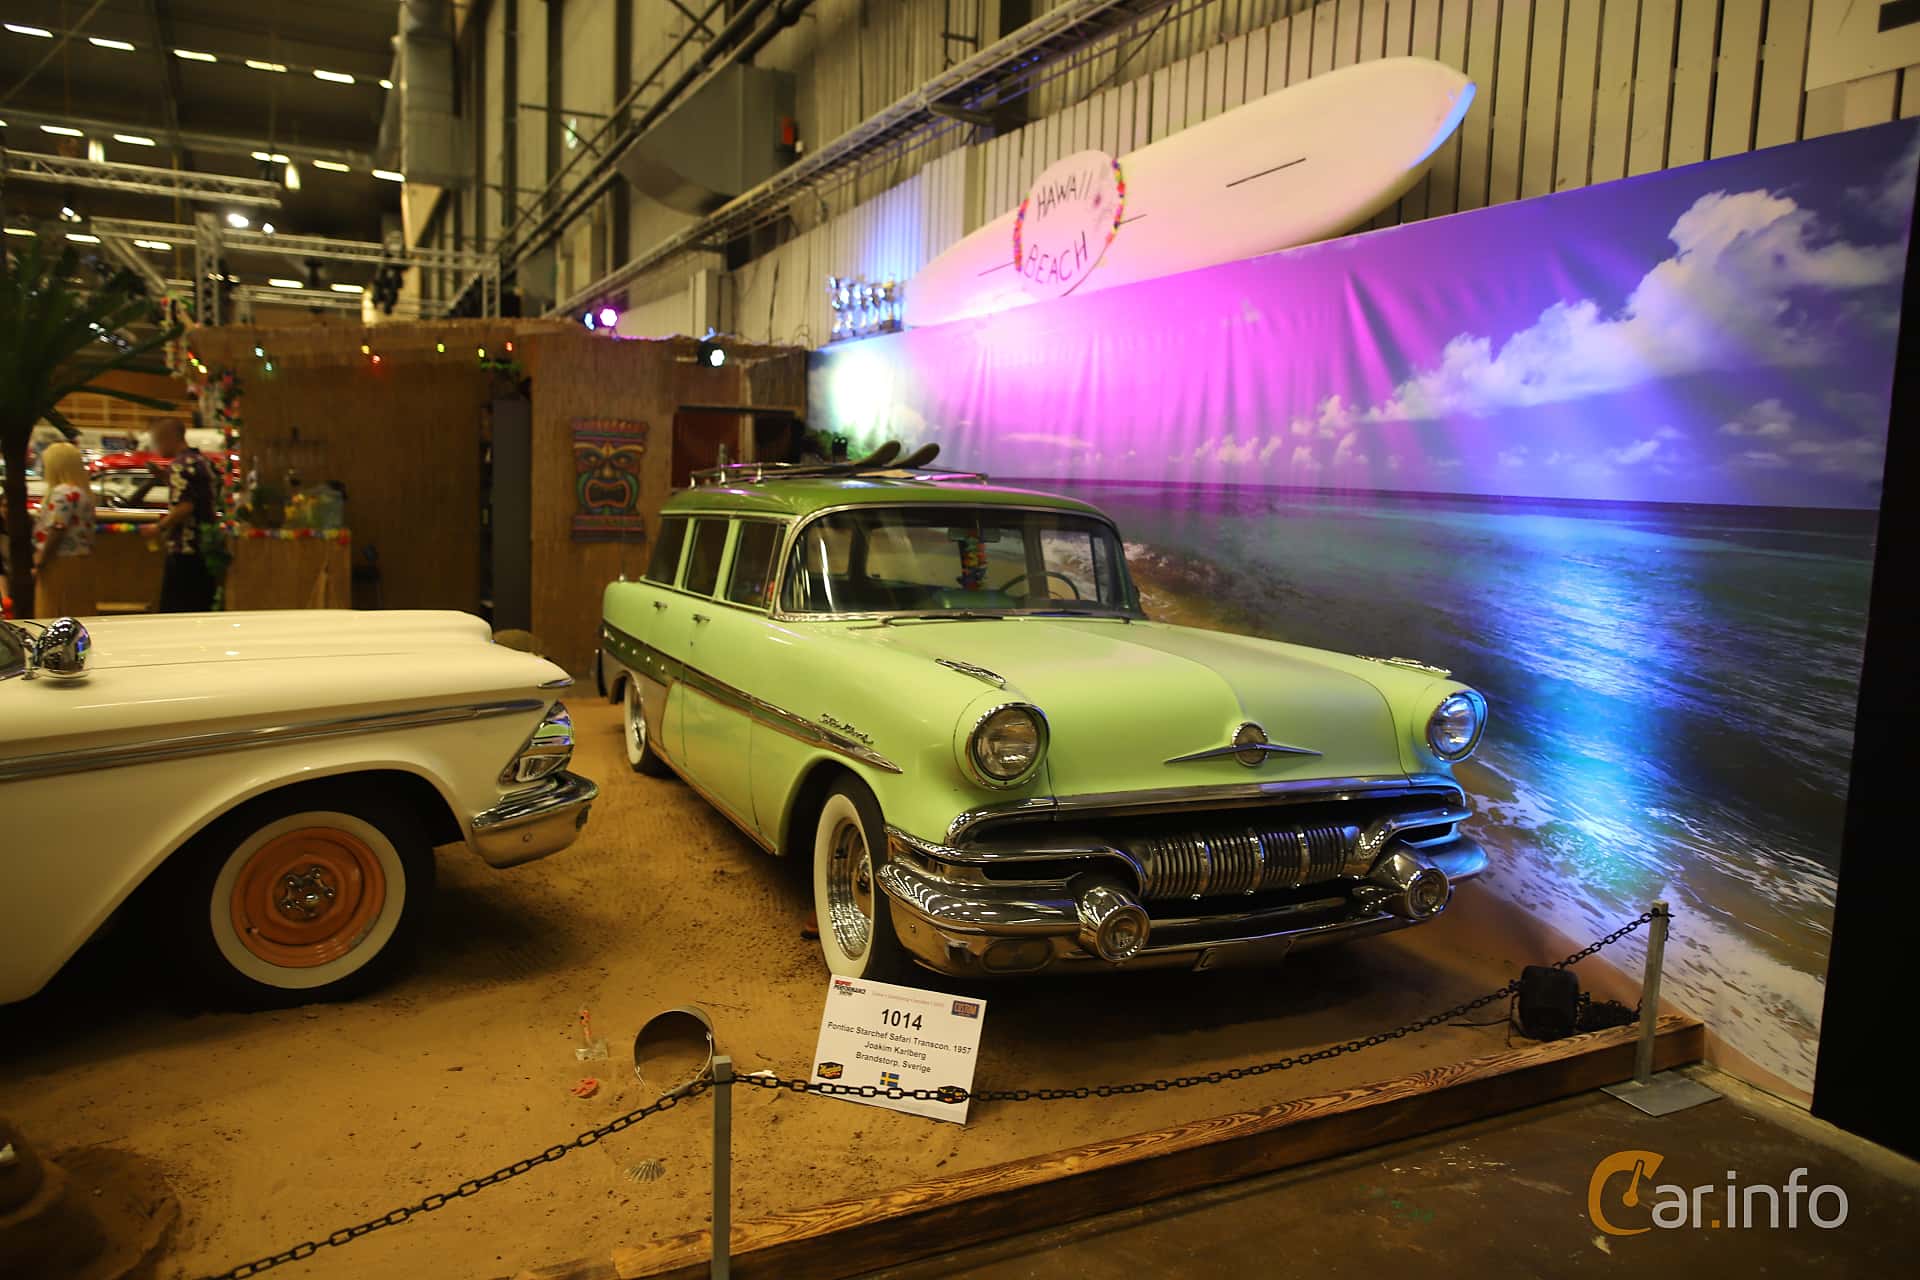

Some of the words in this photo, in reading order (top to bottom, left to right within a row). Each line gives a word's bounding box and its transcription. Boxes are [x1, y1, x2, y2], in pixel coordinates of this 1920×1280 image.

[1036, 169, 1093, 221] HAWAII
[1023, 230, 1088, 283] BEACH
[881, 1008, 922, 1031] 1014
[827, 1021, 855, 1033] Pontiac
[855, 1026, 888, 1040] Starchef
[888, 1032, 911, 1044] Safari
[953, 1045, 972, 1055] 1957
[864, 1041, 893, 1053] Joakim
[894, 1046, 927, 1060] Karlberg
[902, 1060, 932, 1074] Sverige
